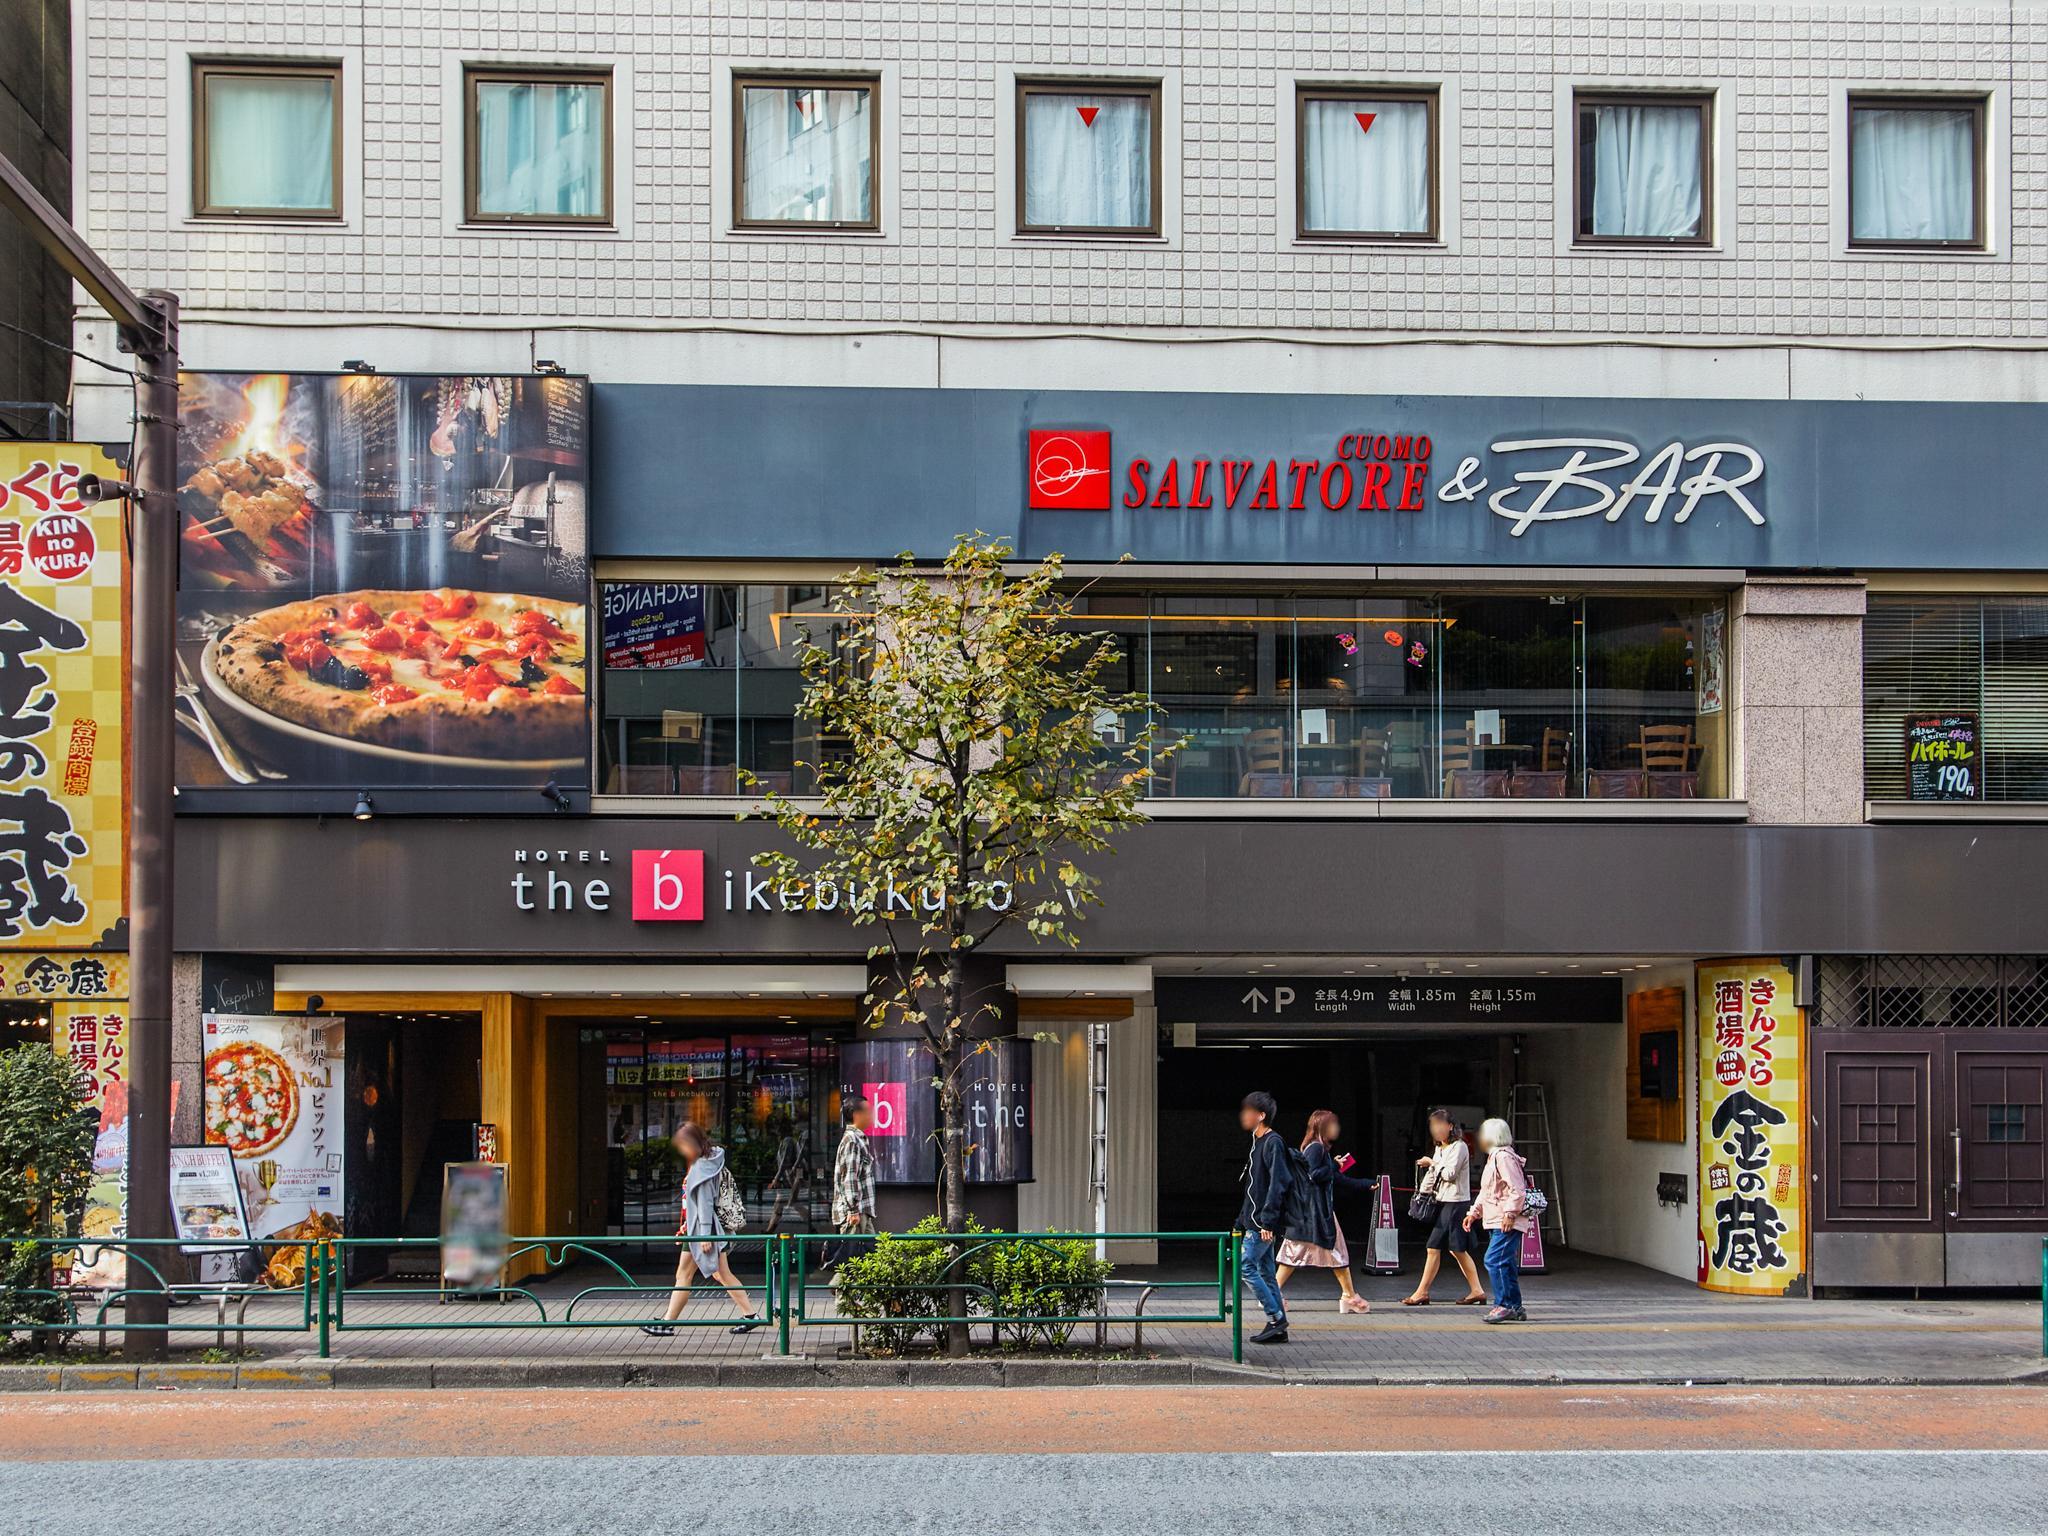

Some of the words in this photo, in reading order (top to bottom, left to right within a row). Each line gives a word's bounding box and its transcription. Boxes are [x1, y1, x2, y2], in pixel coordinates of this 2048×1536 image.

[1337, 433, 1432, 461] CUOMO
[0, 461, 87, 513] くら
[1123, 459, 1429, 512] SALVATORE
[1439, 457, 1488, 502] &
[1488, 435, 1767, 537] BAR
[36, 517, 78, 538] KIN
[47, 536, 75, 552] no
[34, 550, 92, 573] KURA
[64, 718, 97, 797] 登録商標
[1910, 740, 1974, 762] ハイボール
[514, 849, 611, 863] HOTEL
[510, 871, 611, 912] the
[24, 956, 108, 996] 金の蔵
[1275, 986, 1297, 1014] P
[1315, 988, 1339, 1002] 全長
[1340, 988, 1375, 1002] 4.9m
[1388, 988, 1412, 1002] 全幅
[1415, 988, 1457, 1002] 1.85m
[1469, 988, 1493, 1002] 全高
[1496, 988, 1537, 1002] 1.55m
[1315, 1002, 1348, 1013] Length
[1388, 1002, 1416, 1012] Width
[1469, 1002, 1502, 1013] Height
[1715, 980, 1745, 1048] 酒場
[1750, 978, 1777, 1086] きんくら
[69, 1015, 98, 1072] 酒場
[102, 1014, 124, 1097] きんく
[1718, 1052, 1739, 1063] KIN
[1723, 1062, 1737, 1071] no
[974, 1082, 1025, 1092] HOTEL
[1717, 1070, 1745, 1083] KURA
[971, 1099, 1025, 1129] the
[1711, 1089, 1788, 1275] 金の蔵
